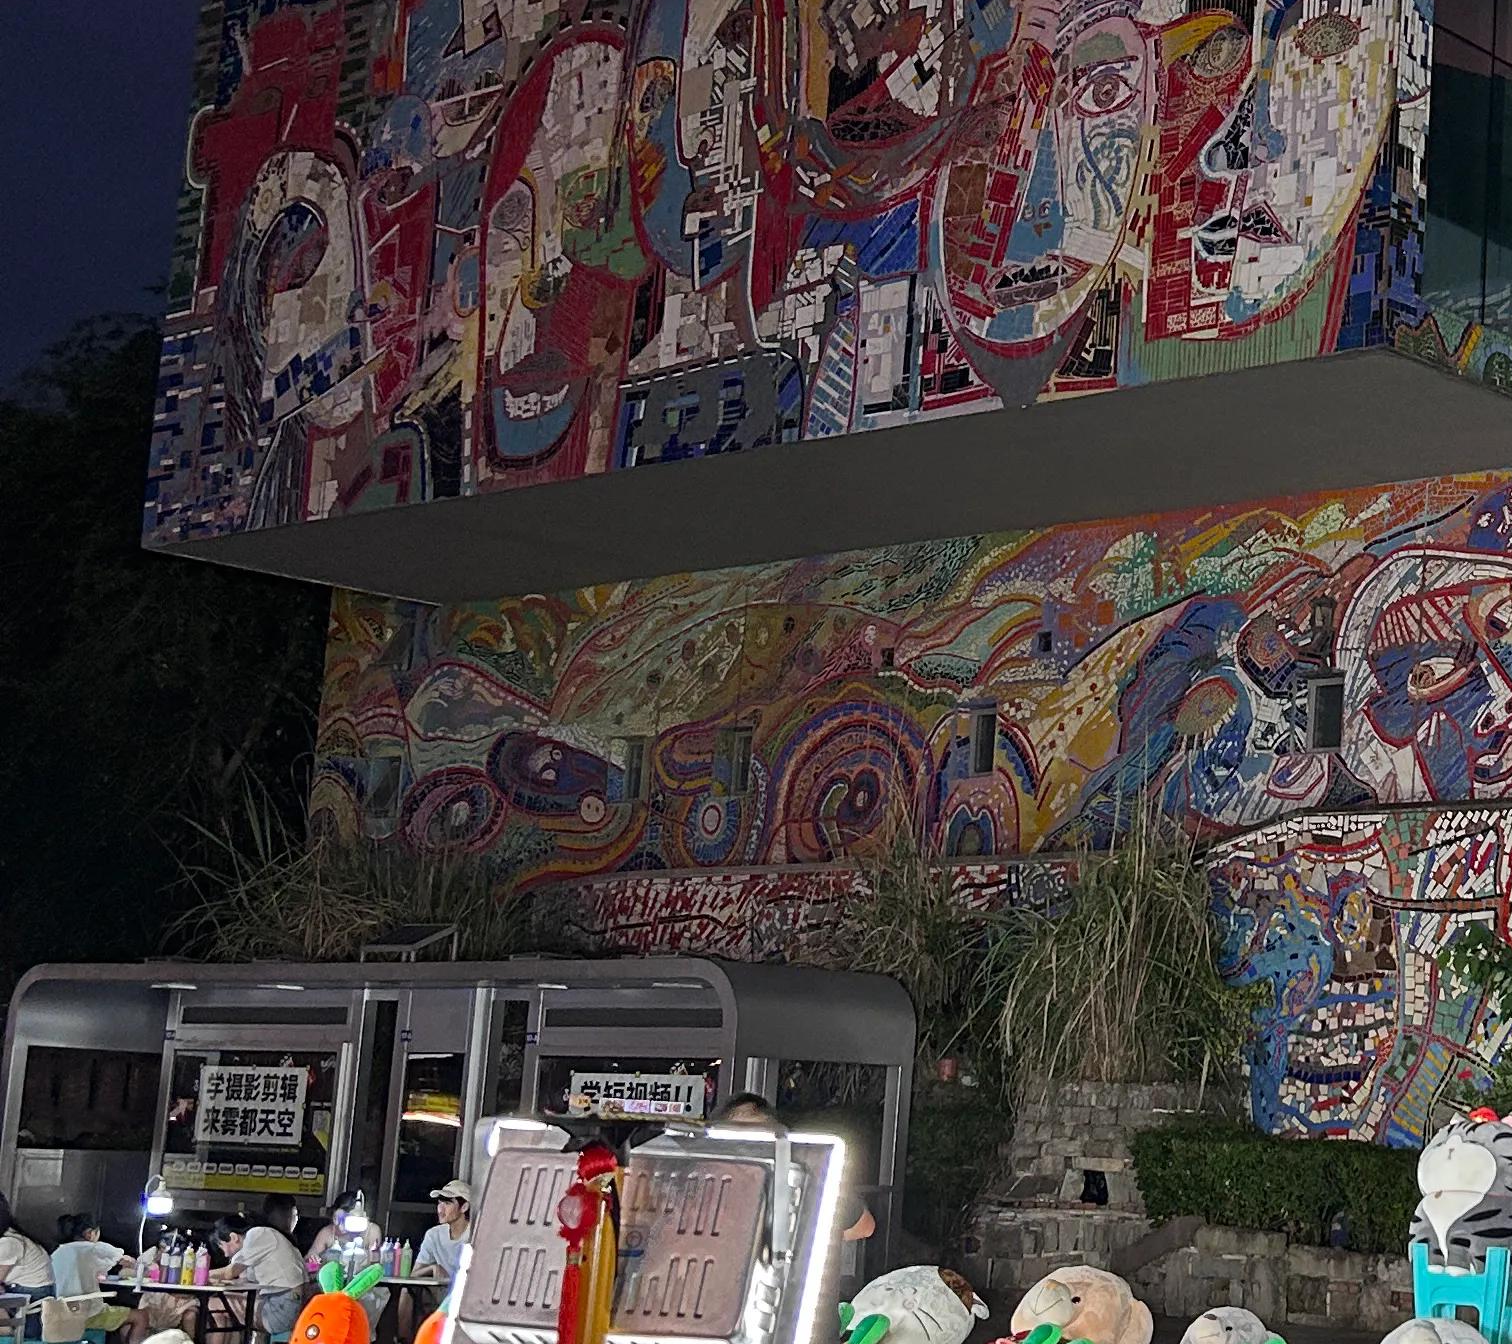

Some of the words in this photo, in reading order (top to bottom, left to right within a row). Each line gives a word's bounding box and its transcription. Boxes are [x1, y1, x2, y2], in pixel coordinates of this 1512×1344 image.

[206, 1073, 299, 1104] 学摄影剪辑
[202, 1107, 296, 1137] 来雾都天空
